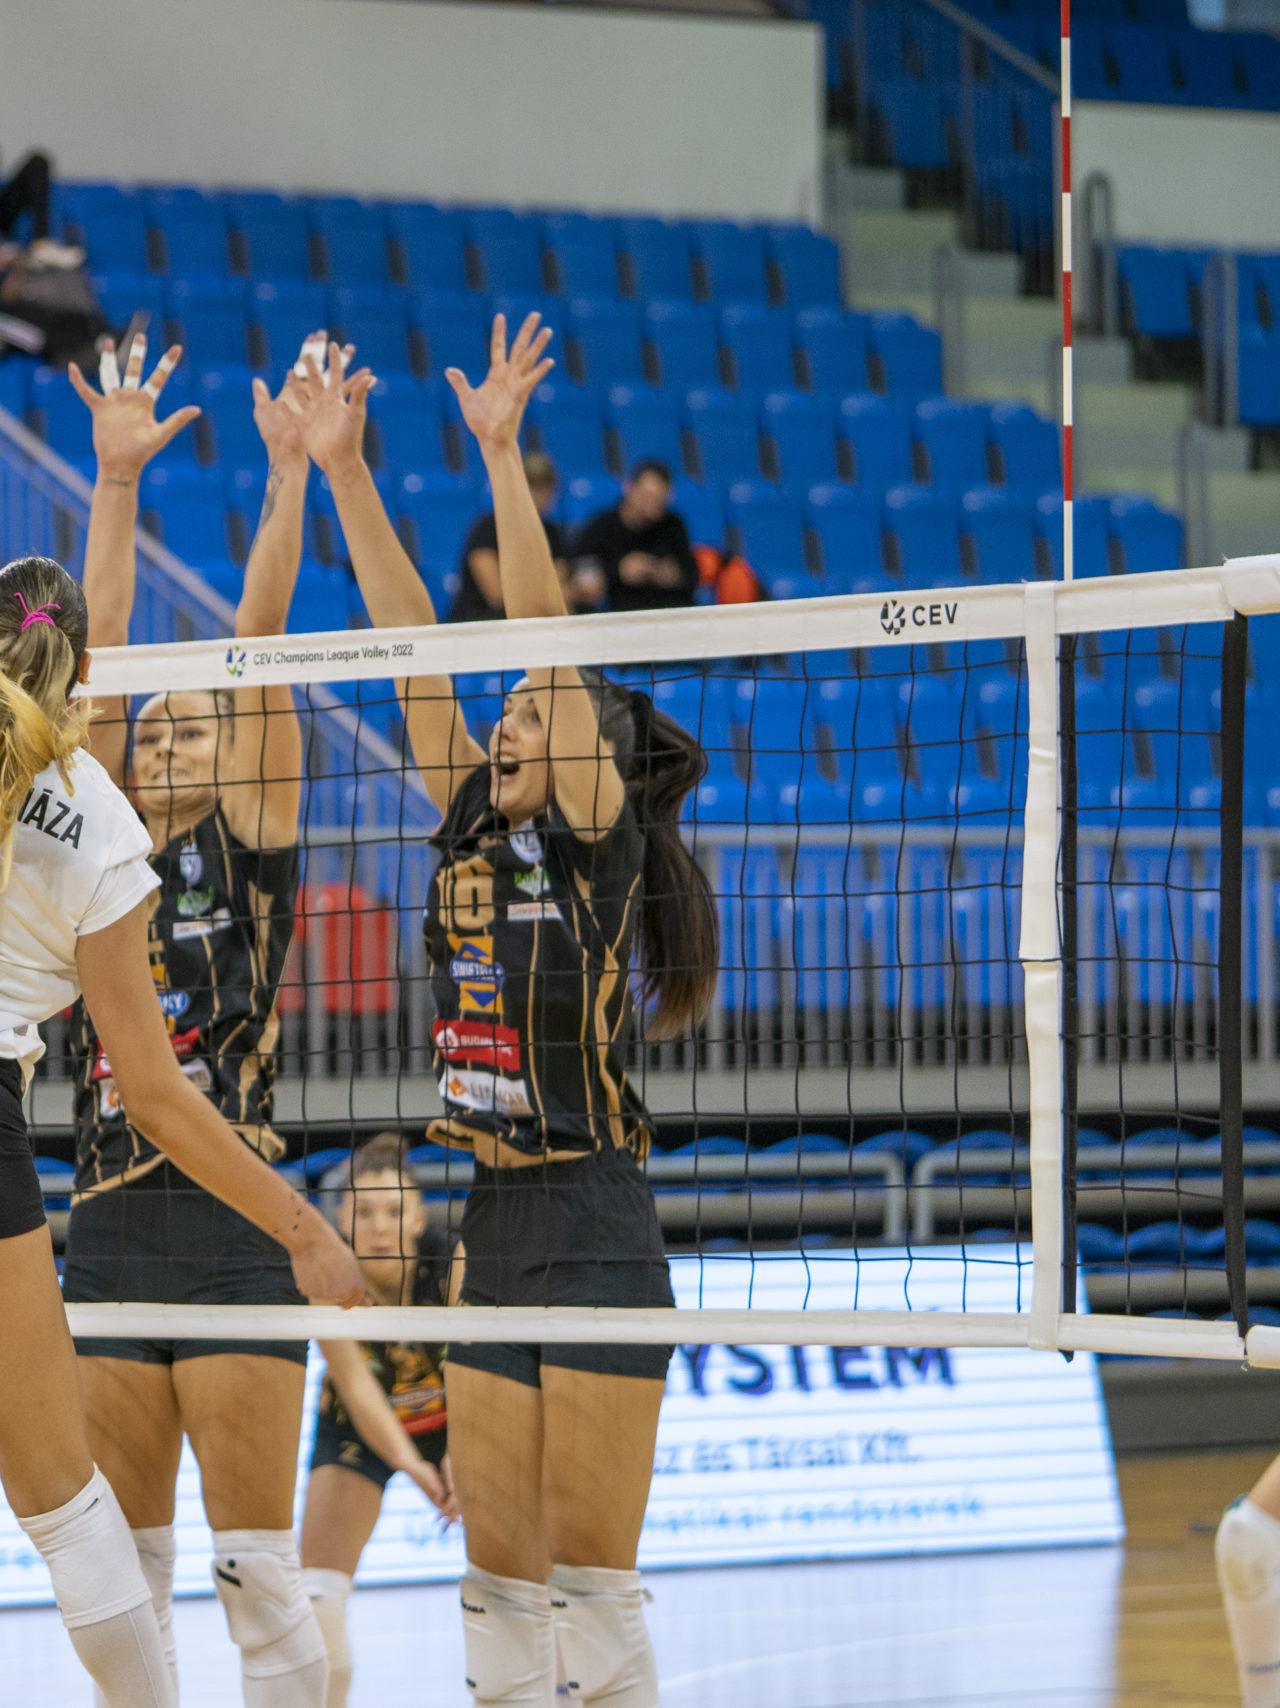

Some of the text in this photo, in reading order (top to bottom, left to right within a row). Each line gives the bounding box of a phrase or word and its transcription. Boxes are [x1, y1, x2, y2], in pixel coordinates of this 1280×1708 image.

[912, 602, 958, 627] CEV
[252, 643, 415, 665] CEV Champions League Volley 2022
[670, 1344, 955, 1398] YSTEM
